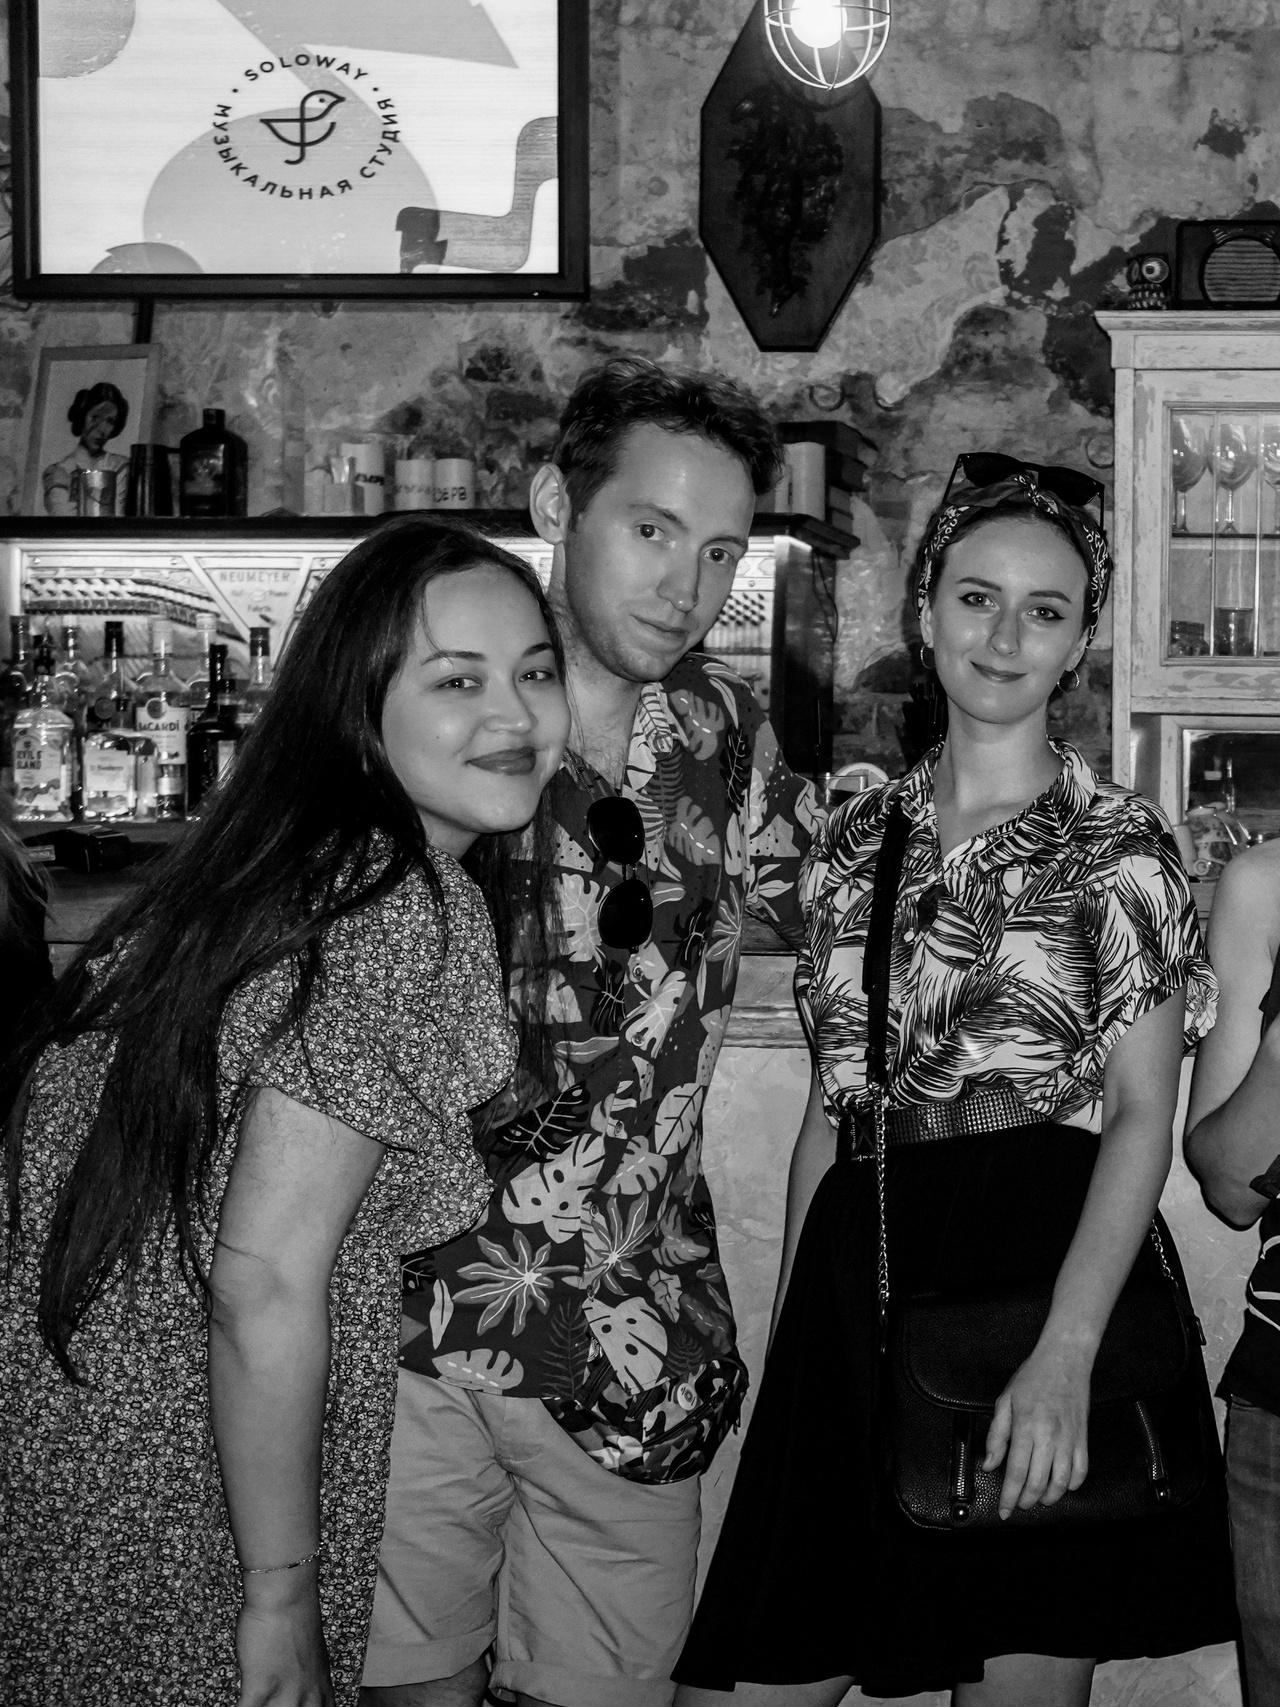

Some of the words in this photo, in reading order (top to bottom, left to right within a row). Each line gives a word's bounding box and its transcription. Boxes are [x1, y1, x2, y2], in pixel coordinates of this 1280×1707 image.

[244, 54, 369, 81] SOLOWAY
[213, 104, 353, 200] МУЗЫКАЛЬНАЯ
[360, 98, 401, 179] СТУДИЯ
